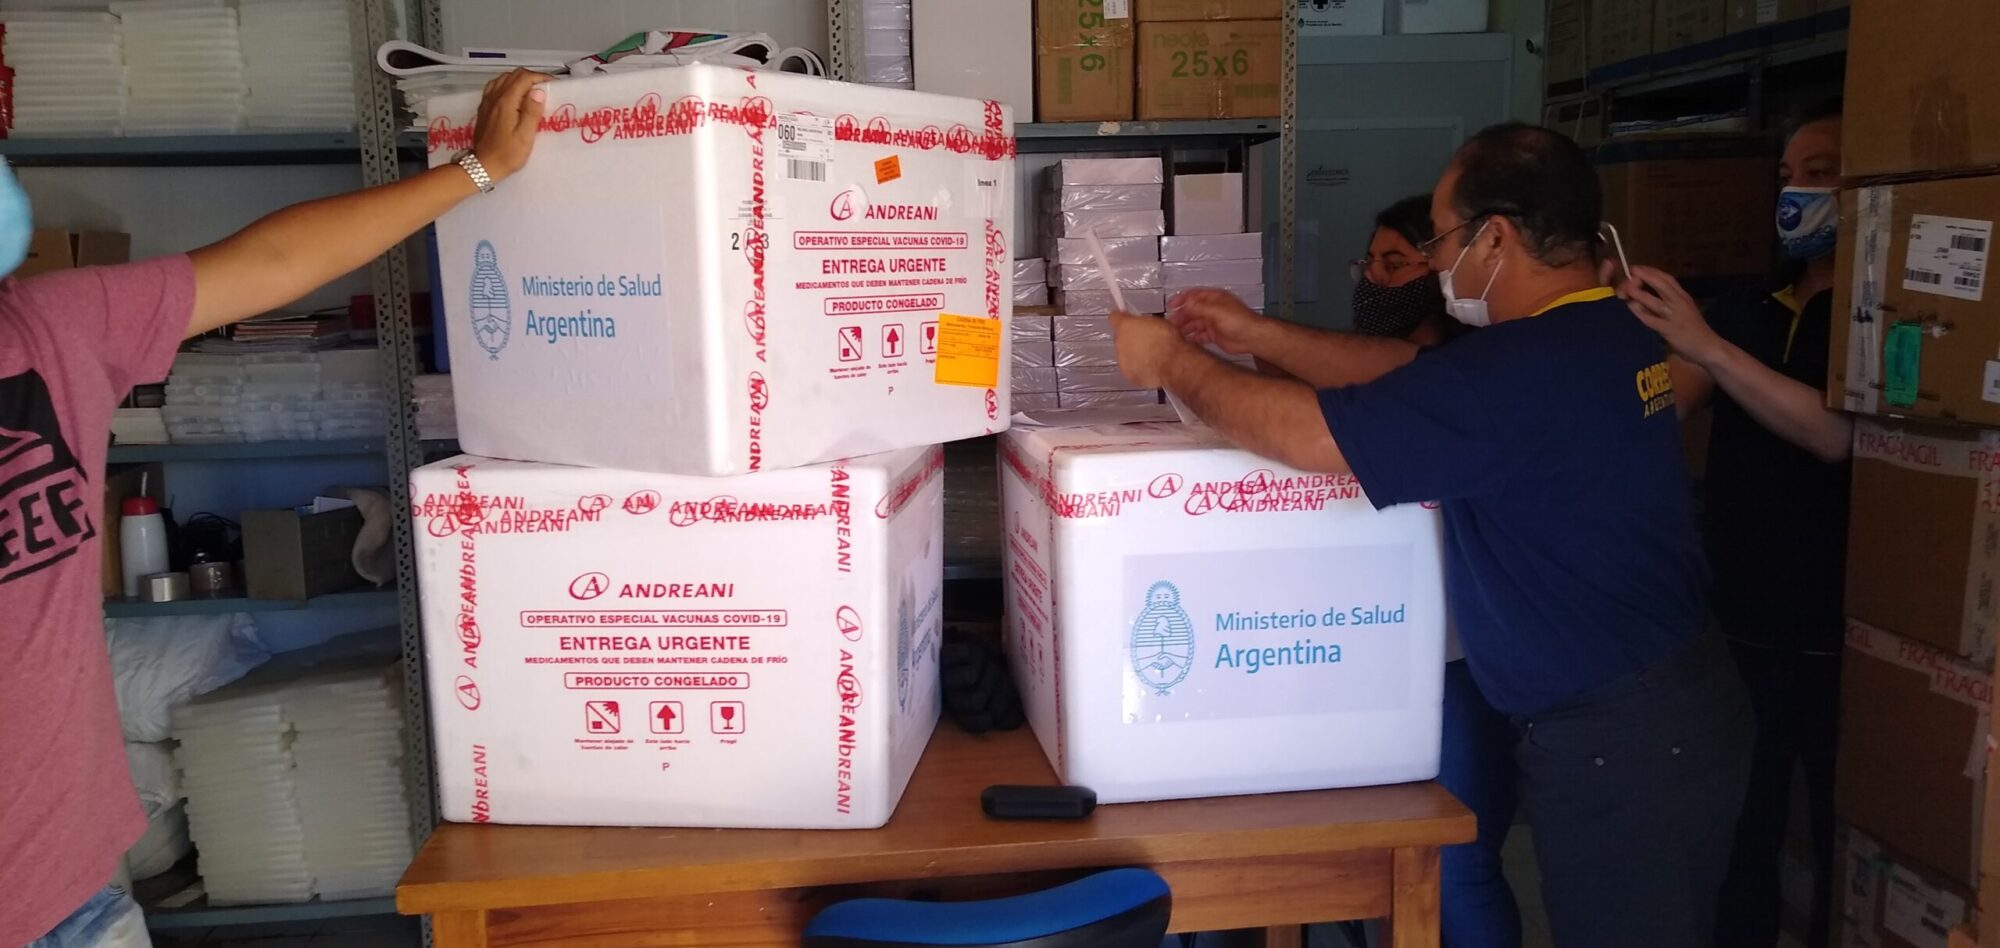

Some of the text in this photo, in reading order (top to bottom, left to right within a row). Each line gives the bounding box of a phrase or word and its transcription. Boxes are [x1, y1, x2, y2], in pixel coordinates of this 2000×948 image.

[777, 124, 796, 142] 060
[865, 204, 939, 221] ANDREANI
[731, 232, 740, 250] 2
[799, 235, 965, 247] OPERATIVO ESPECIAL VACUNAS COVID-19
[822, 258, 947, 274] ENTREGA URGENTE
[522, 273, 662, 297] Ministerio de Salud
[795, 281, 850, 290] MEDICAMENTOS
[851, 280, 865, 288] QUE
[866, 279, 888, 288] DEBEN
[889, 278, 921, 288] MANTENER
[922, 278, 944, 286] CADENA
[832, 297, 938, 312] PRODUCTO CONGELADO
[525, 309, 617, 344] Argentina
[500, 508, 601, 523] ANDREANI
[471, 519, 571, 535] ANDREANI
[619, 583, 734, 599] ANDREANI
[527, 614, 781, 624] OPERATIVO ESPECIAL VACUNAS COVID-19
[1215, 603, 1405, 631] Ministerio de Salud
[560, 636, 751, 651] ENTREGA URGENTE
[601, 656, 620, 665] QUE
[657, 656, 708, 664] MANTENER
[711, 656, 748, 664] CADENA
[751, 656, 764, 664] DE
[1214, 638, 1342, 674] Argentina
[575, 676, 738, 687] PRODUCTO CONGELADO
[662, 762, 670, 772] P
